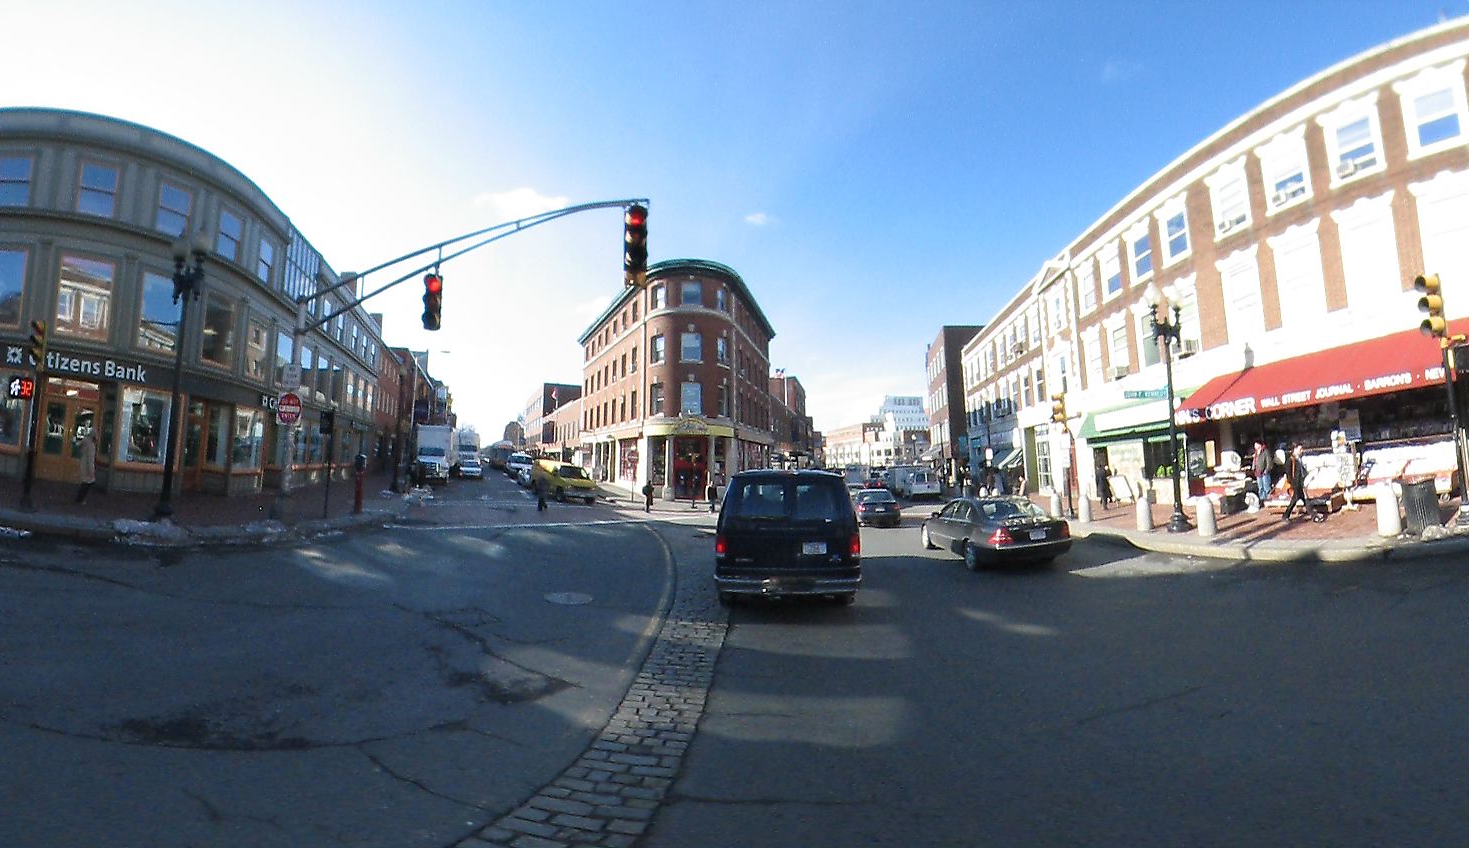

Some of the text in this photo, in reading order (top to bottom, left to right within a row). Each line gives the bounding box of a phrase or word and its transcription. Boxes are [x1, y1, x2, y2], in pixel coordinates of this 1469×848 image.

[29, 351, 147, 383] Ctizens Bank
[21, 379, 33, 397] 32
[1261, 396, 1281, 408] WALL
[1282, 390, 1311, 405] STREET
[1315, 383, 1354, 400] JOURNAL
[1364, 372, 1412, 391] BARRON'S
[1205, 397, 1257, 420] CORNER
